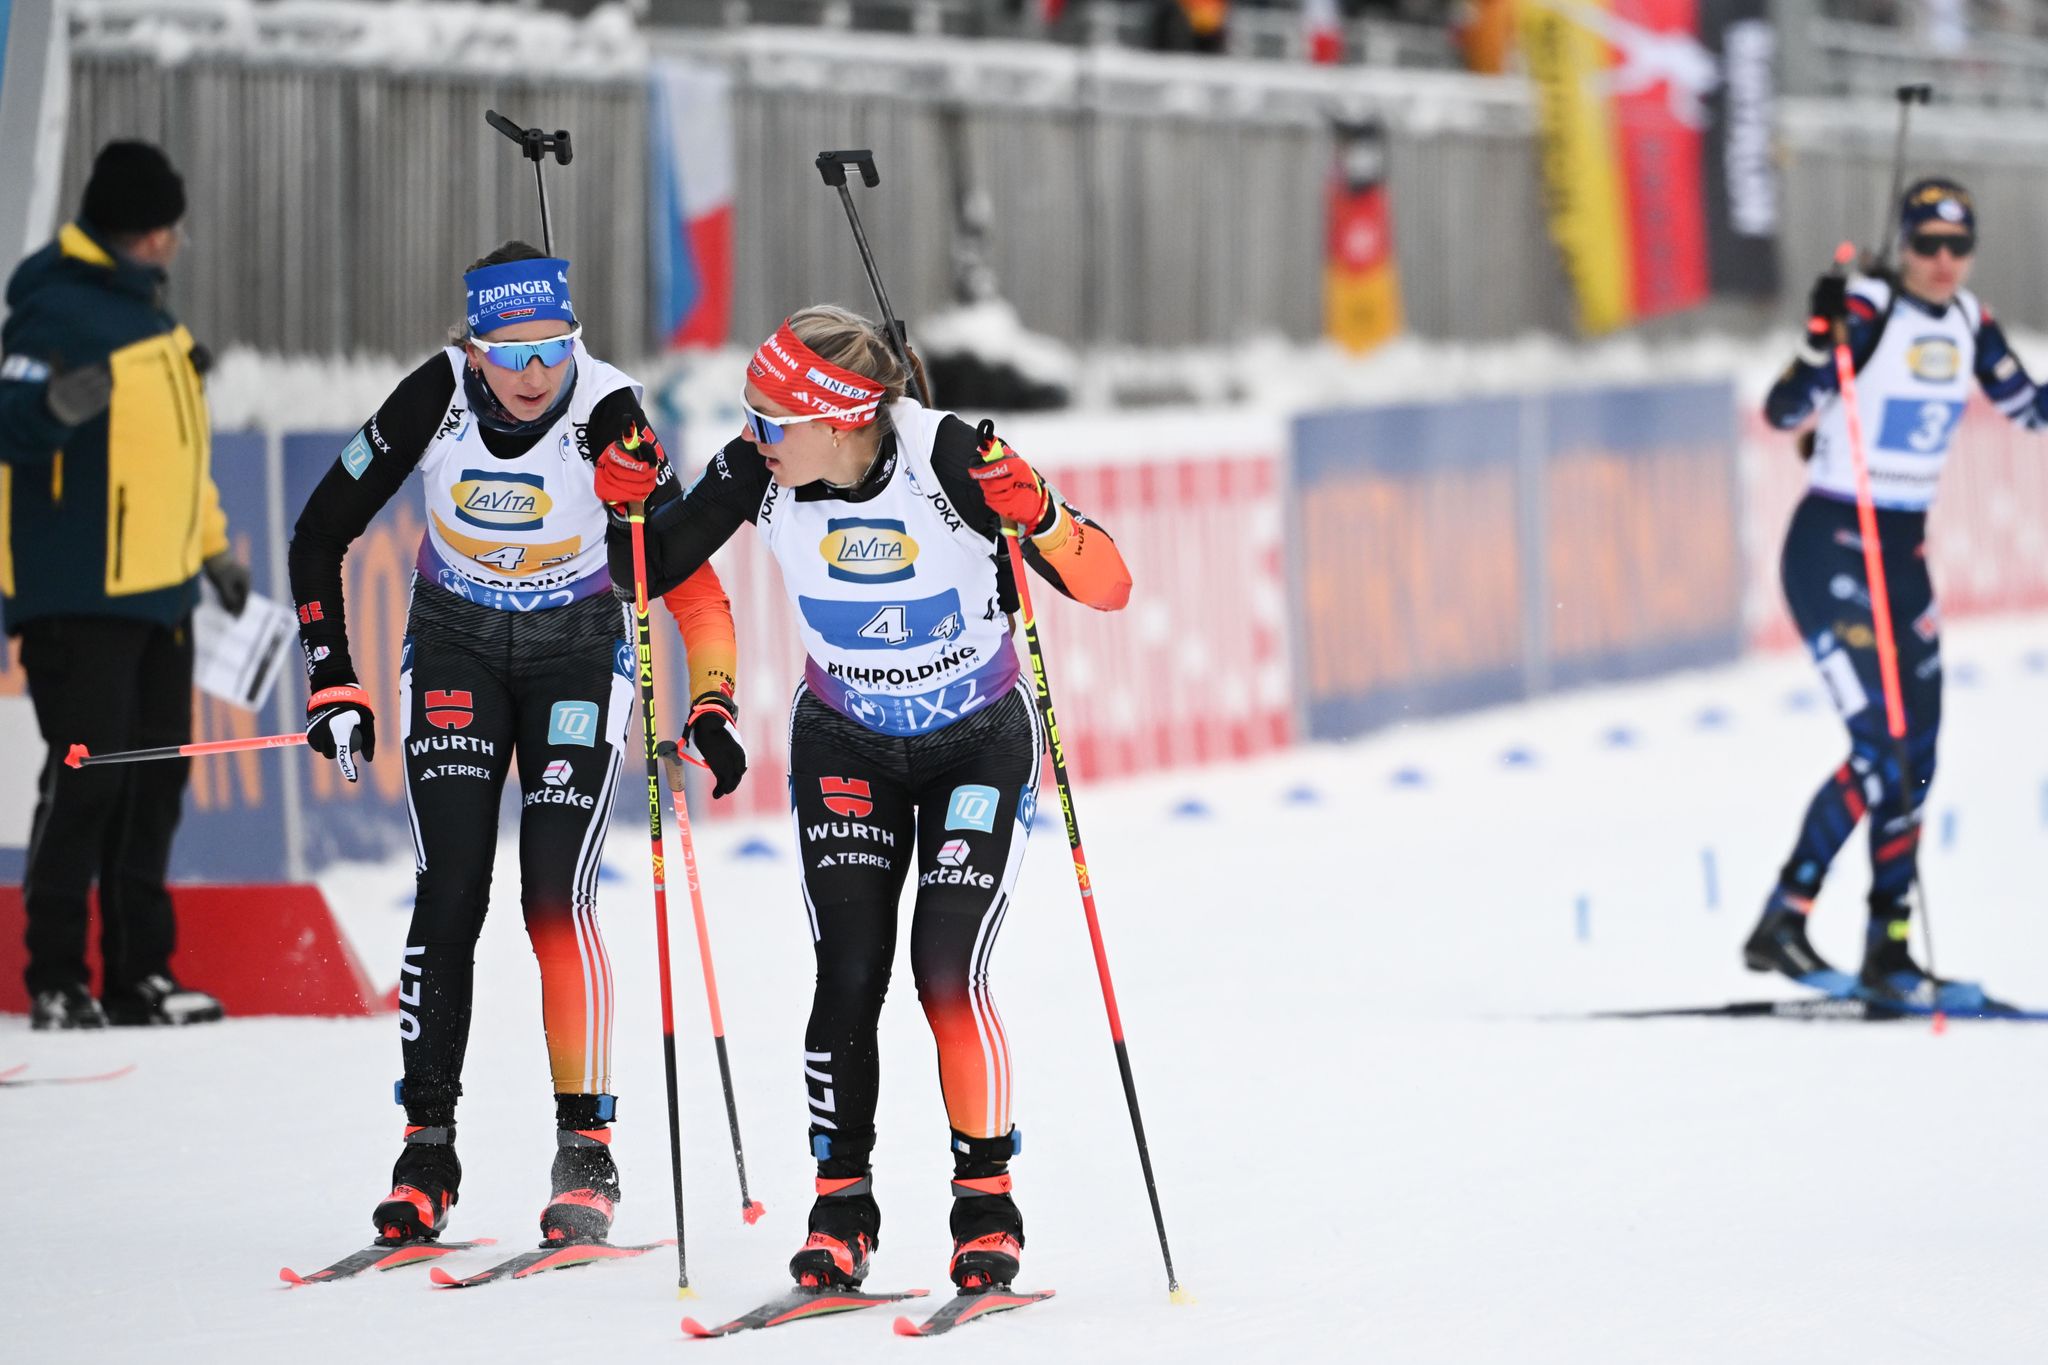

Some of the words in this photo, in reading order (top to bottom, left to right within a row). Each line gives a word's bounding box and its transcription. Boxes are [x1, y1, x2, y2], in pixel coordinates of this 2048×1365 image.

[478, 280, 554, 306] ERDINGER
[480, 296, 556, 316] ALKOHOLFREI
[1908, 401, 1951, 451] 3
[608, 449, 644, 472] Roeckl
[972, 464, 1009, 480] Roeckl
[927, 492, 962, 532] JOKA
[474, 546, 527, 570] 4
[858, 605, 912, 645] 4
[928, 612, 961, 639] 4
[637, 626, 652, 687] LEKI
[558, 707, 591, 740] TQ
[410, 734, 495, 757] WÜRTH
[437, 764, 491, 781] TERREX
[955, 791, 987, 825] TQ
[806, 822, 895, 847] WÜRTH
[836, 852, 892, 870] TERREX
